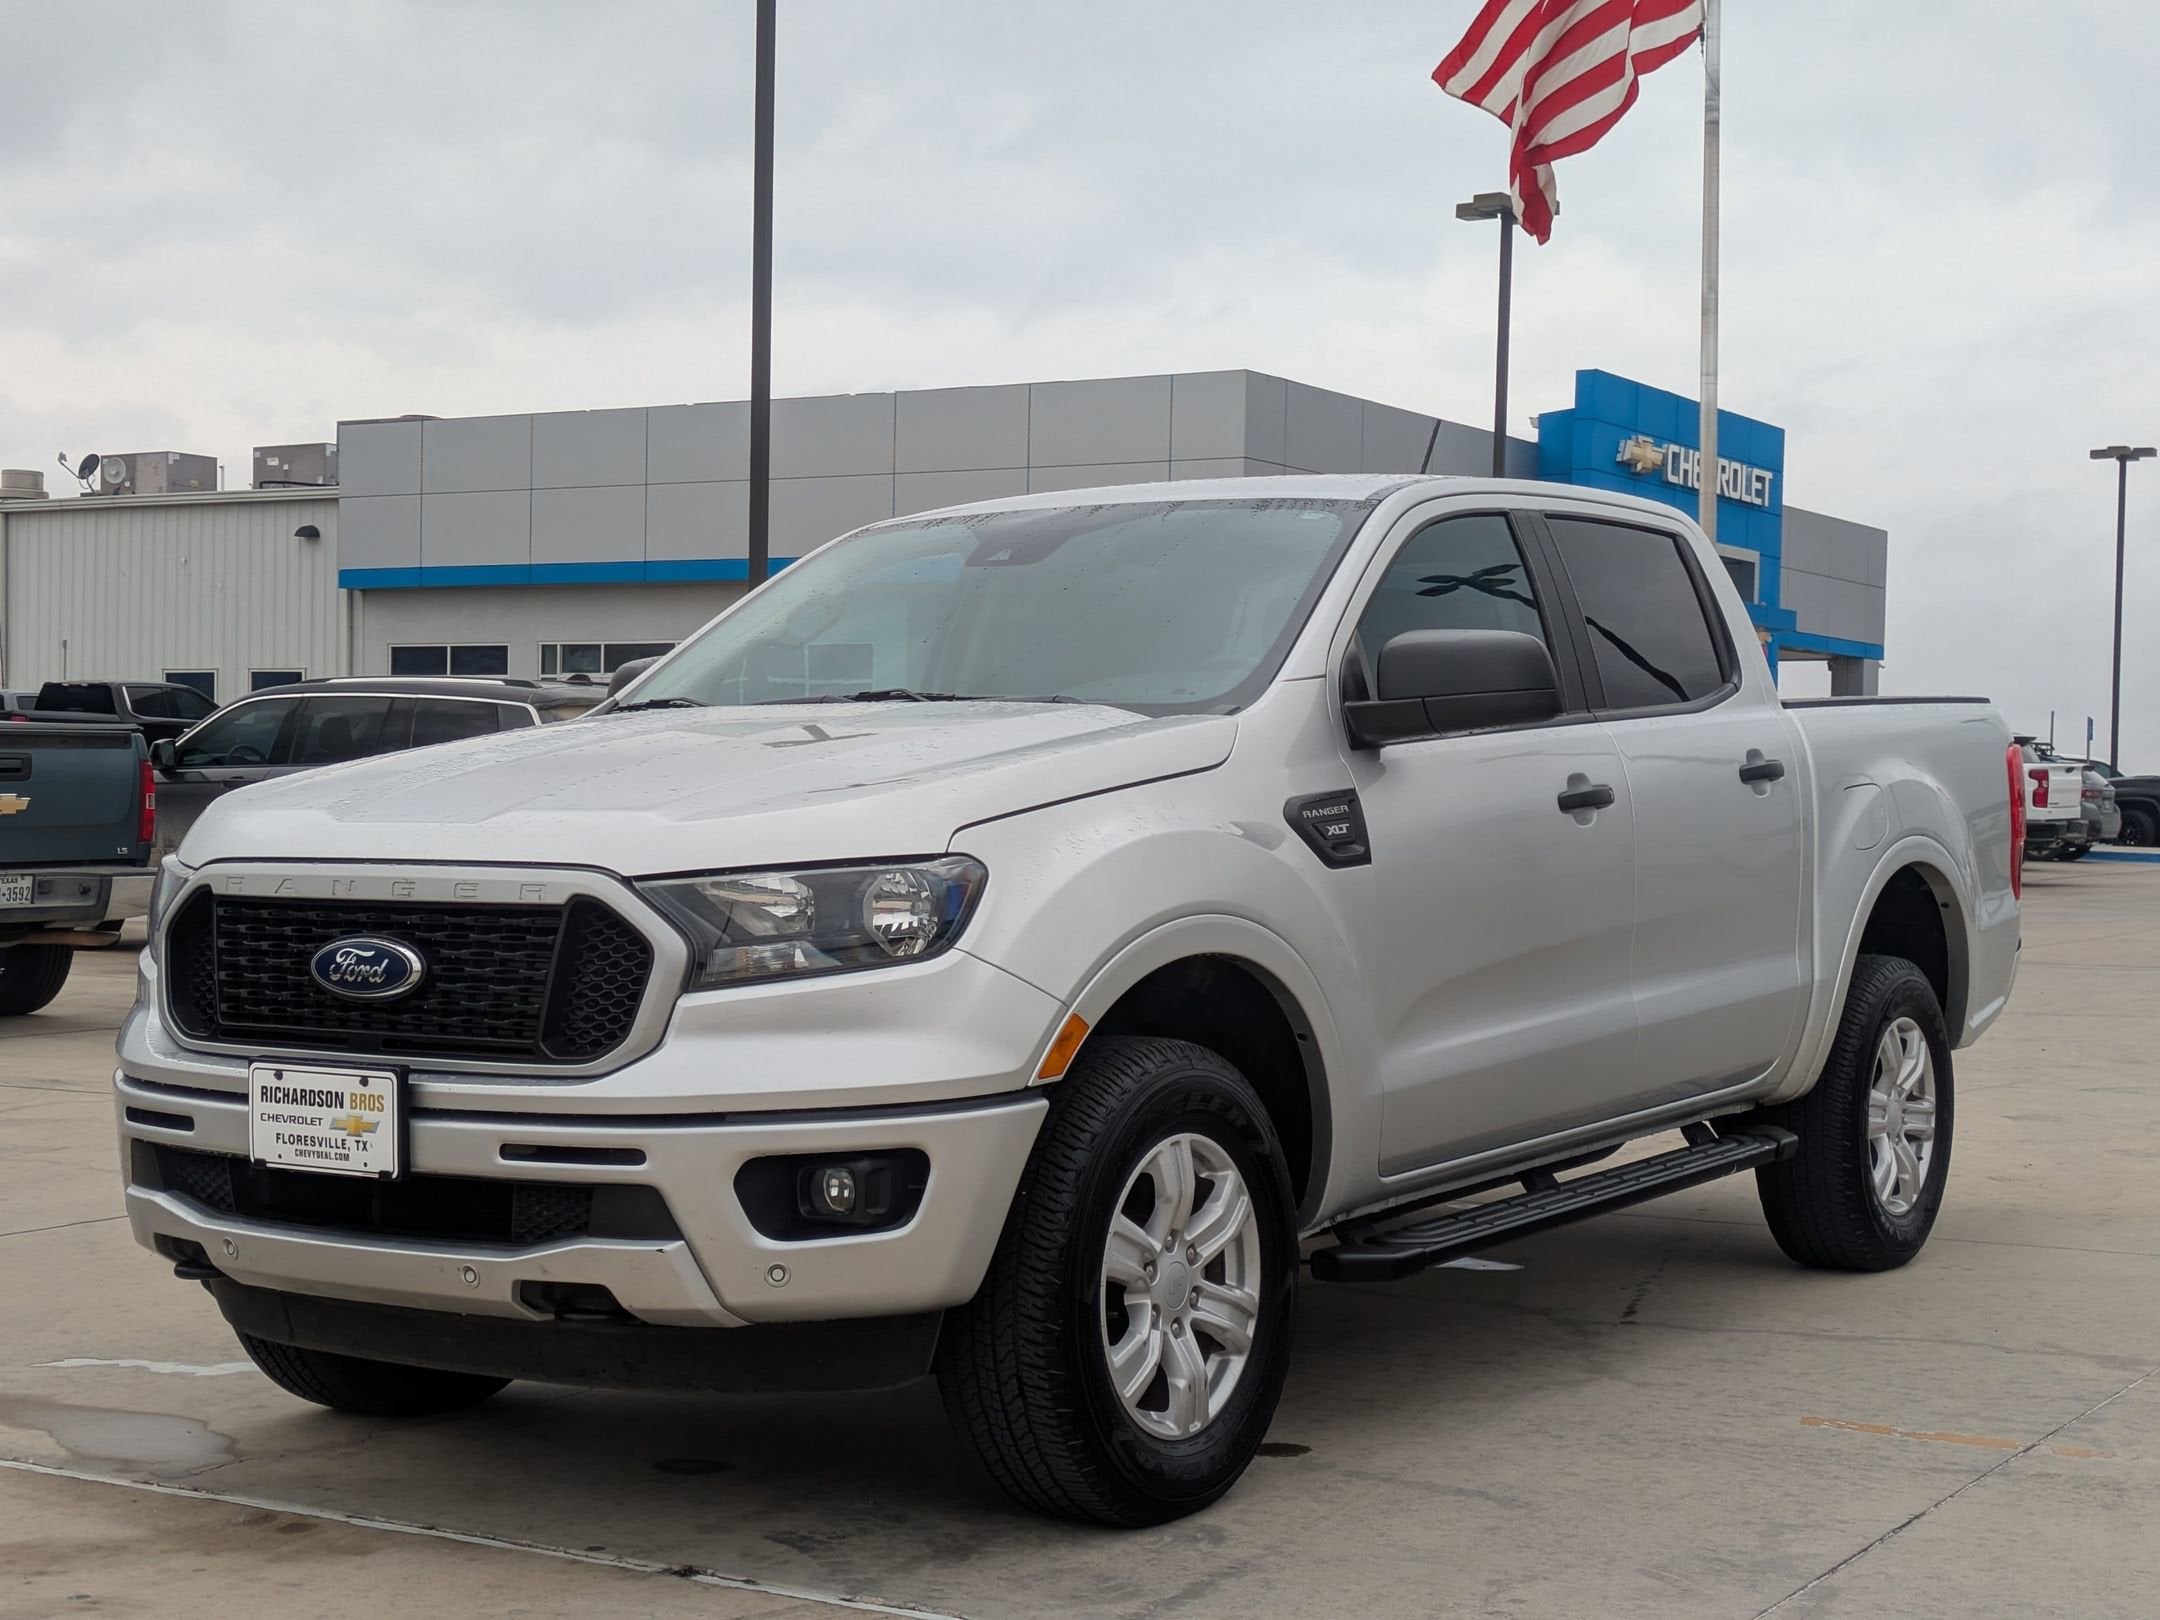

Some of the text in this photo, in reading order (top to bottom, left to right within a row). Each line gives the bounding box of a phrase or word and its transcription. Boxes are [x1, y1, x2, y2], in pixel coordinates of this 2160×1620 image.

[1665, 443, 1773, 507] CHEROLET
[1302, 804, 1349, 819] RANGER
[1326, 823, 1350, 836] XLT
[0, 876, 18, 885] EXAS
[224, 876, 547, 901] RANGER
[329, 948, 387, 984] Ford
[260, 1085, 385, 1113] RICHARDSON BROS
[260, 1112, 324, 1127] CHEVROLET
[275, 1132, 369, 1153] FLORESVILLE, TX
[294, 1148, 350, 1162] CHEVYDEAL.COM
